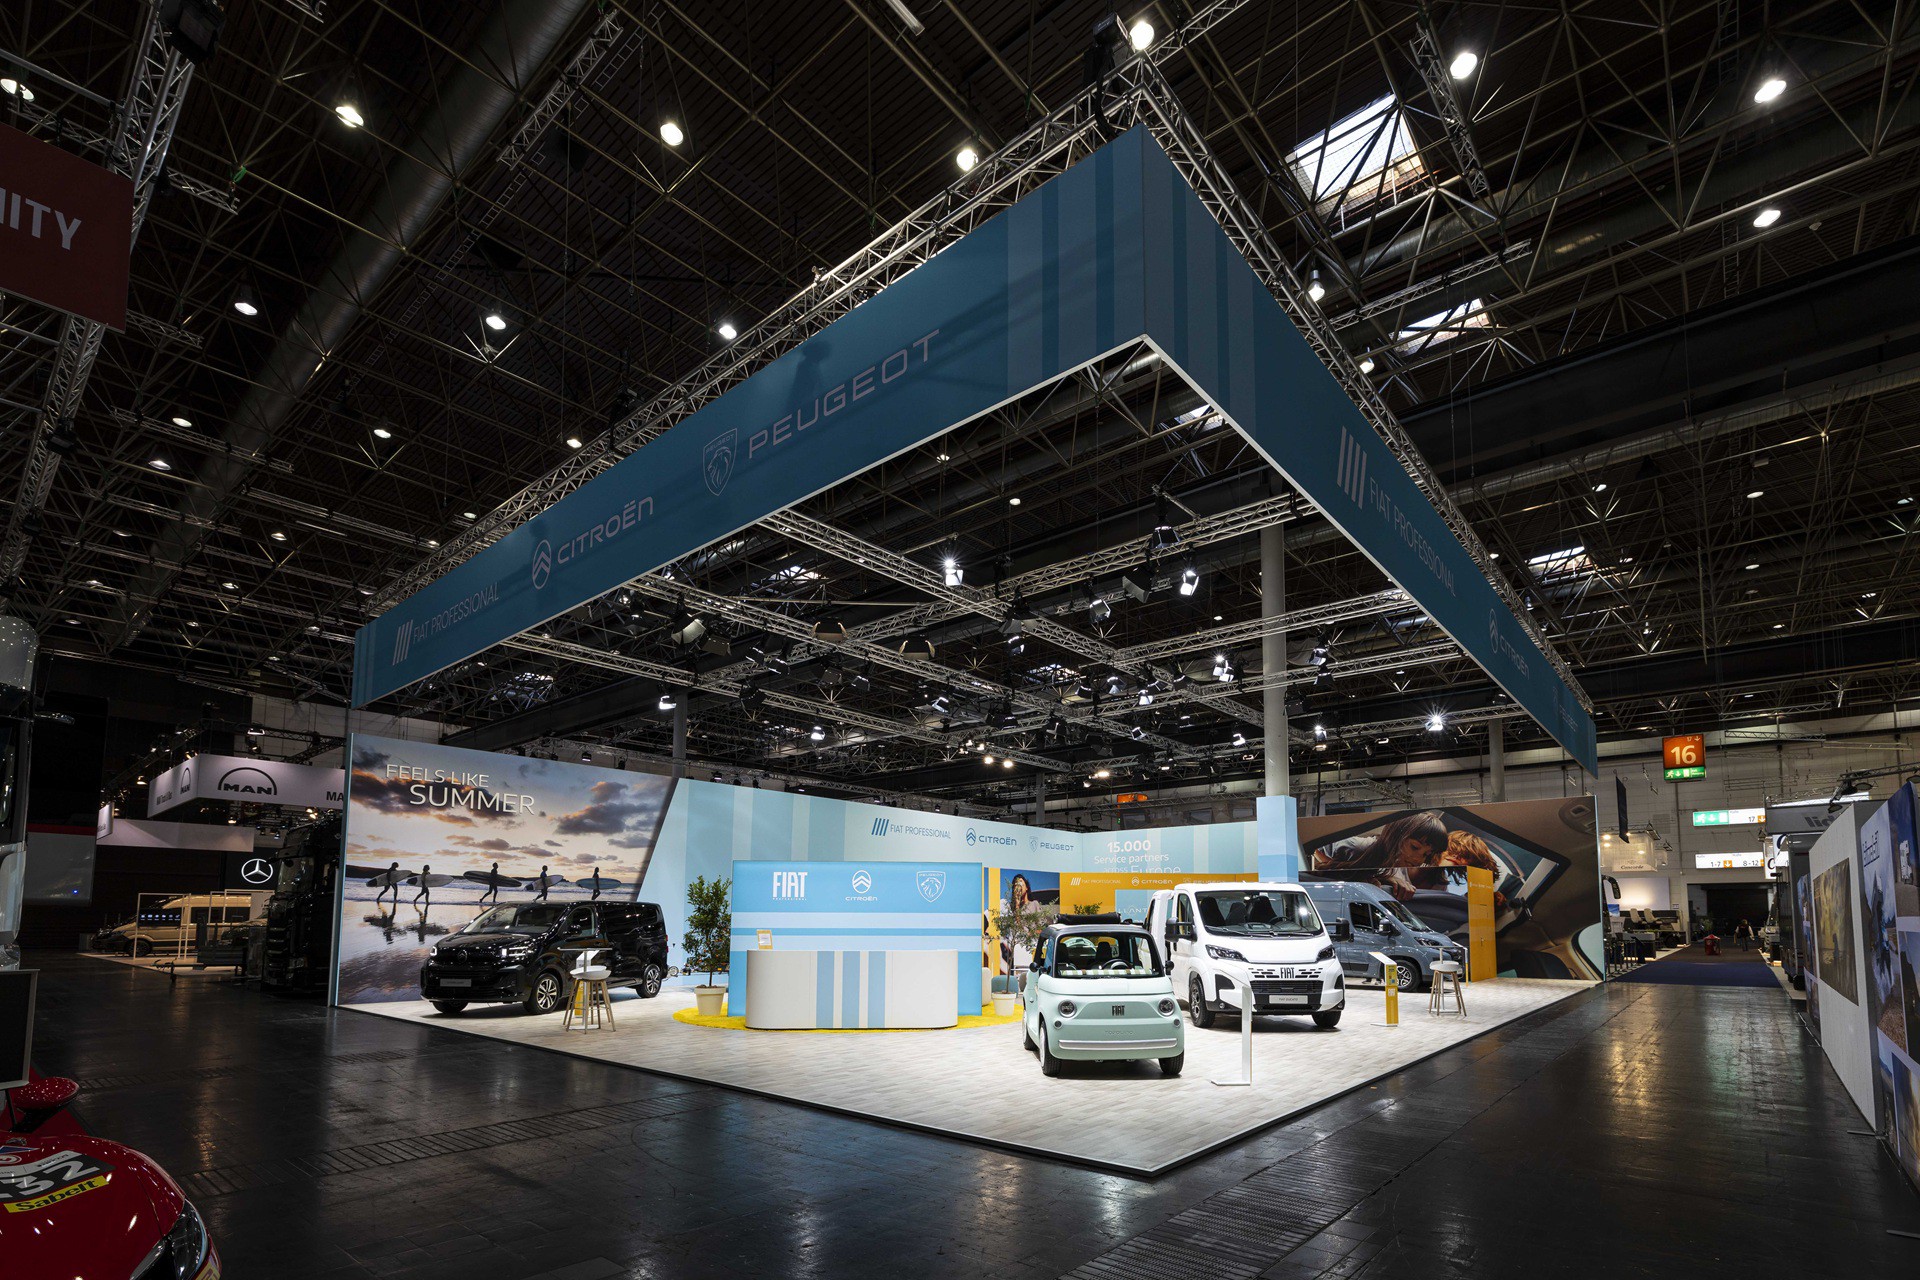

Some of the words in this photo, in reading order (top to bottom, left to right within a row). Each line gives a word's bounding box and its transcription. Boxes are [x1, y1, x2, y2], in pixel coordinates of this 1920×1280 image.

[0, 186, 82, 250] ITY
[749, 329, 940, 459] PEUGEOT
[557, 496, 654, 565] CITROËN
[1369, 476, 1391, 524] FIAT
[1393, 508, 1457, 598] PROFESSIONAL
[412, 620, 429, 645] FIAT
[430, 582, 500, 636] PROFESSIONAL
[1670, 744, 1696, 765] 16
[386, 764, 445, 784] FEELS
[451, 771, 489, 788] LIKE
[223, 783, 272, 796] MAN
[409, 784, 535, 815] SUMMER
[890, 824, 903, 834] FIAT
[905, 826, 951, 840] PROFESSIONAL
[978, 834, 1017, 846] CITROËN
[1040, 842, 1074, 851] PEUGEOT
[1107, 840, 1152, 853] 15.000
[1094, 855, 1126, 864] Service
[1128, 854, 1170, 864] partners
[772, 872, 808, 898] FIAT
[1280, 967, 1294, 978] FIAT
[1112, 1005, 1125, 1016] FIAT
[0, 1160, 100, 1199] 32
[16, 1180, 98, 1211] Sabelt
